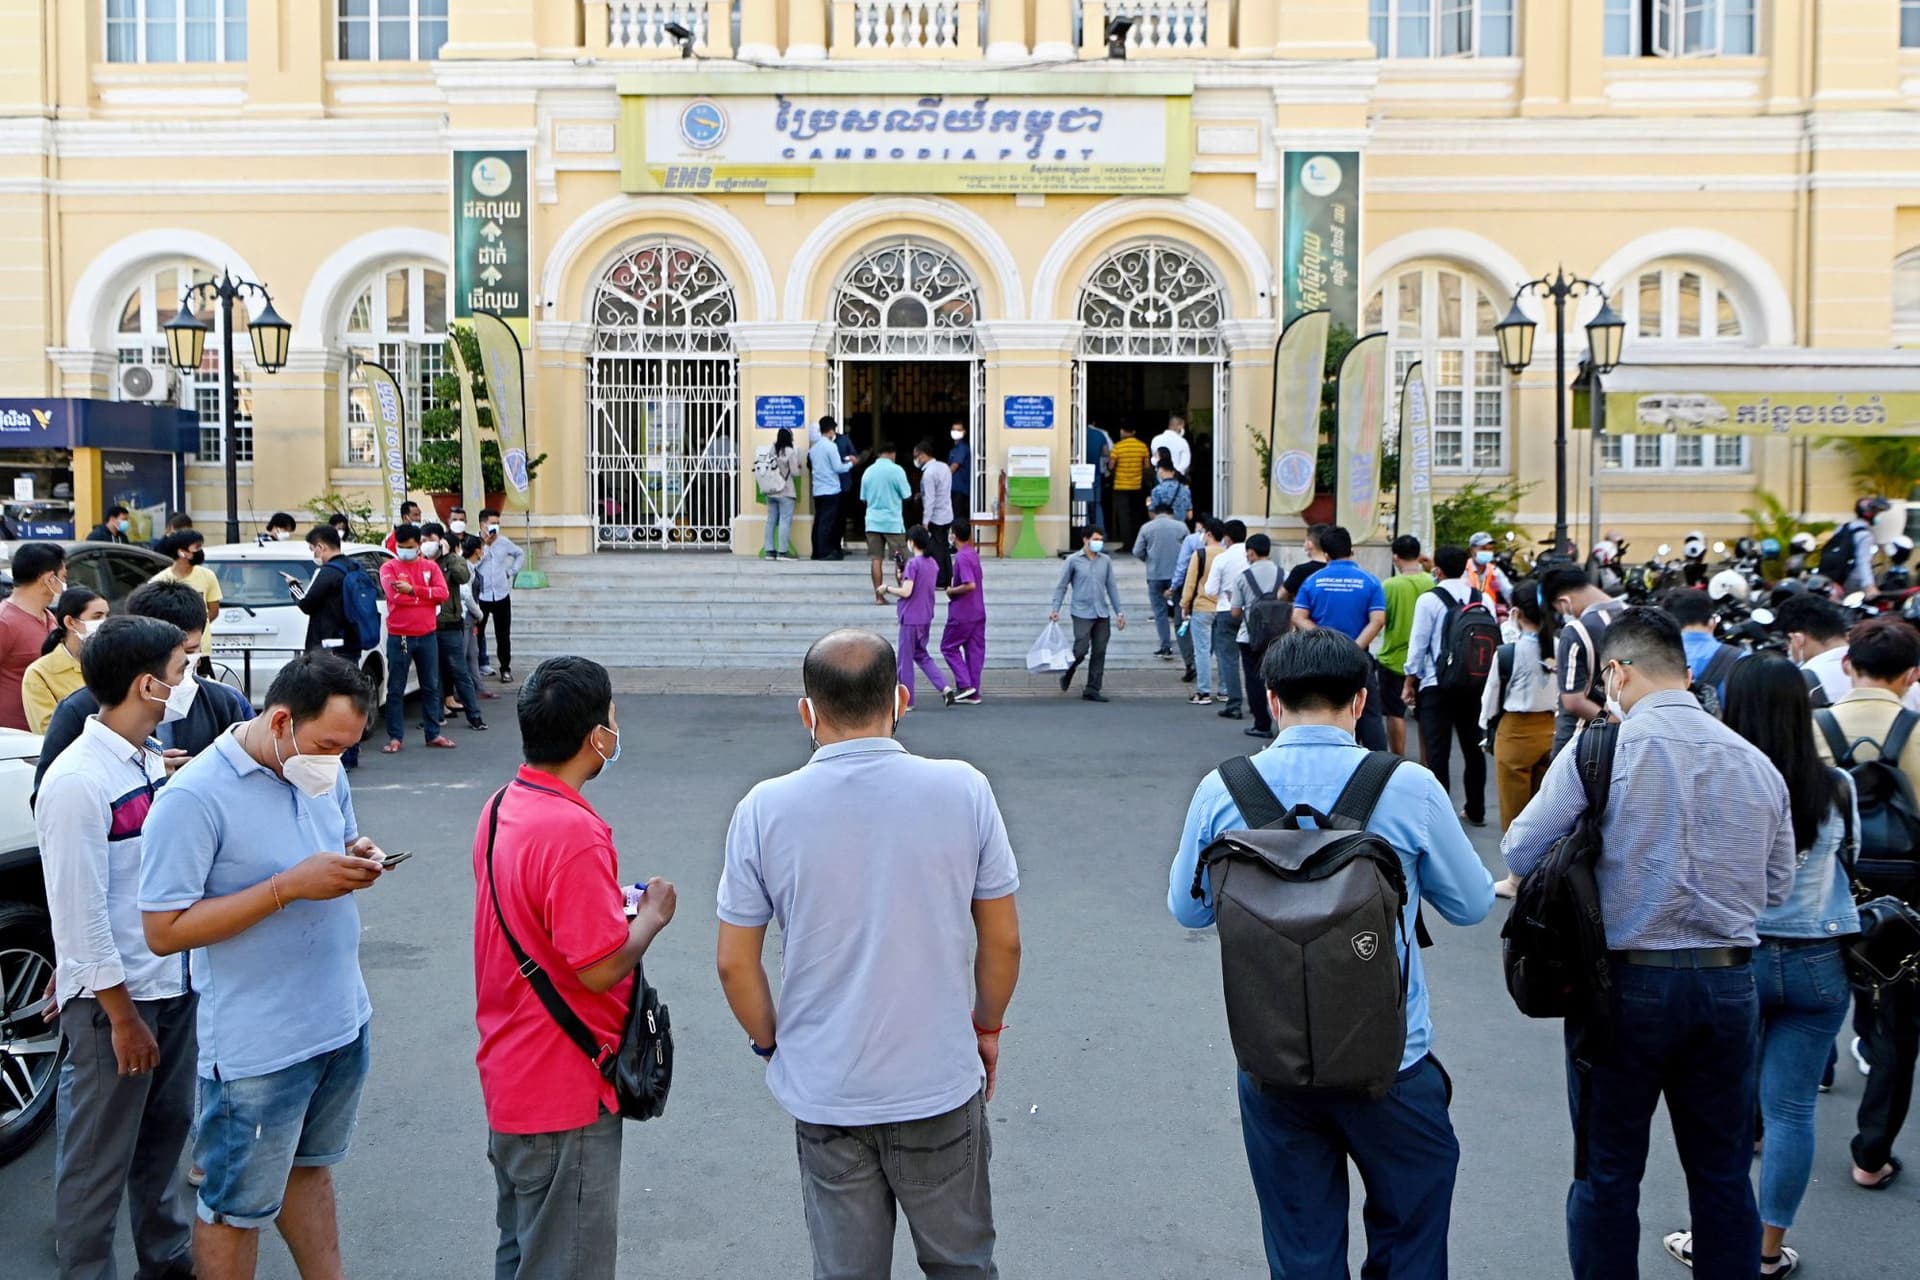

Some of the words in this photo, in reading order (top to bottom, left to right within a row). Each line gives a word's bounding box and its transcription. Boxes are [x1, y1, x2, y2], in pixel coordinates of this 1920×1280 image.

[782, 148, 976, 159] CAMBODIA
[1000, 148, 1094, 159] POST
[664, 166, 712, 188] EMS
